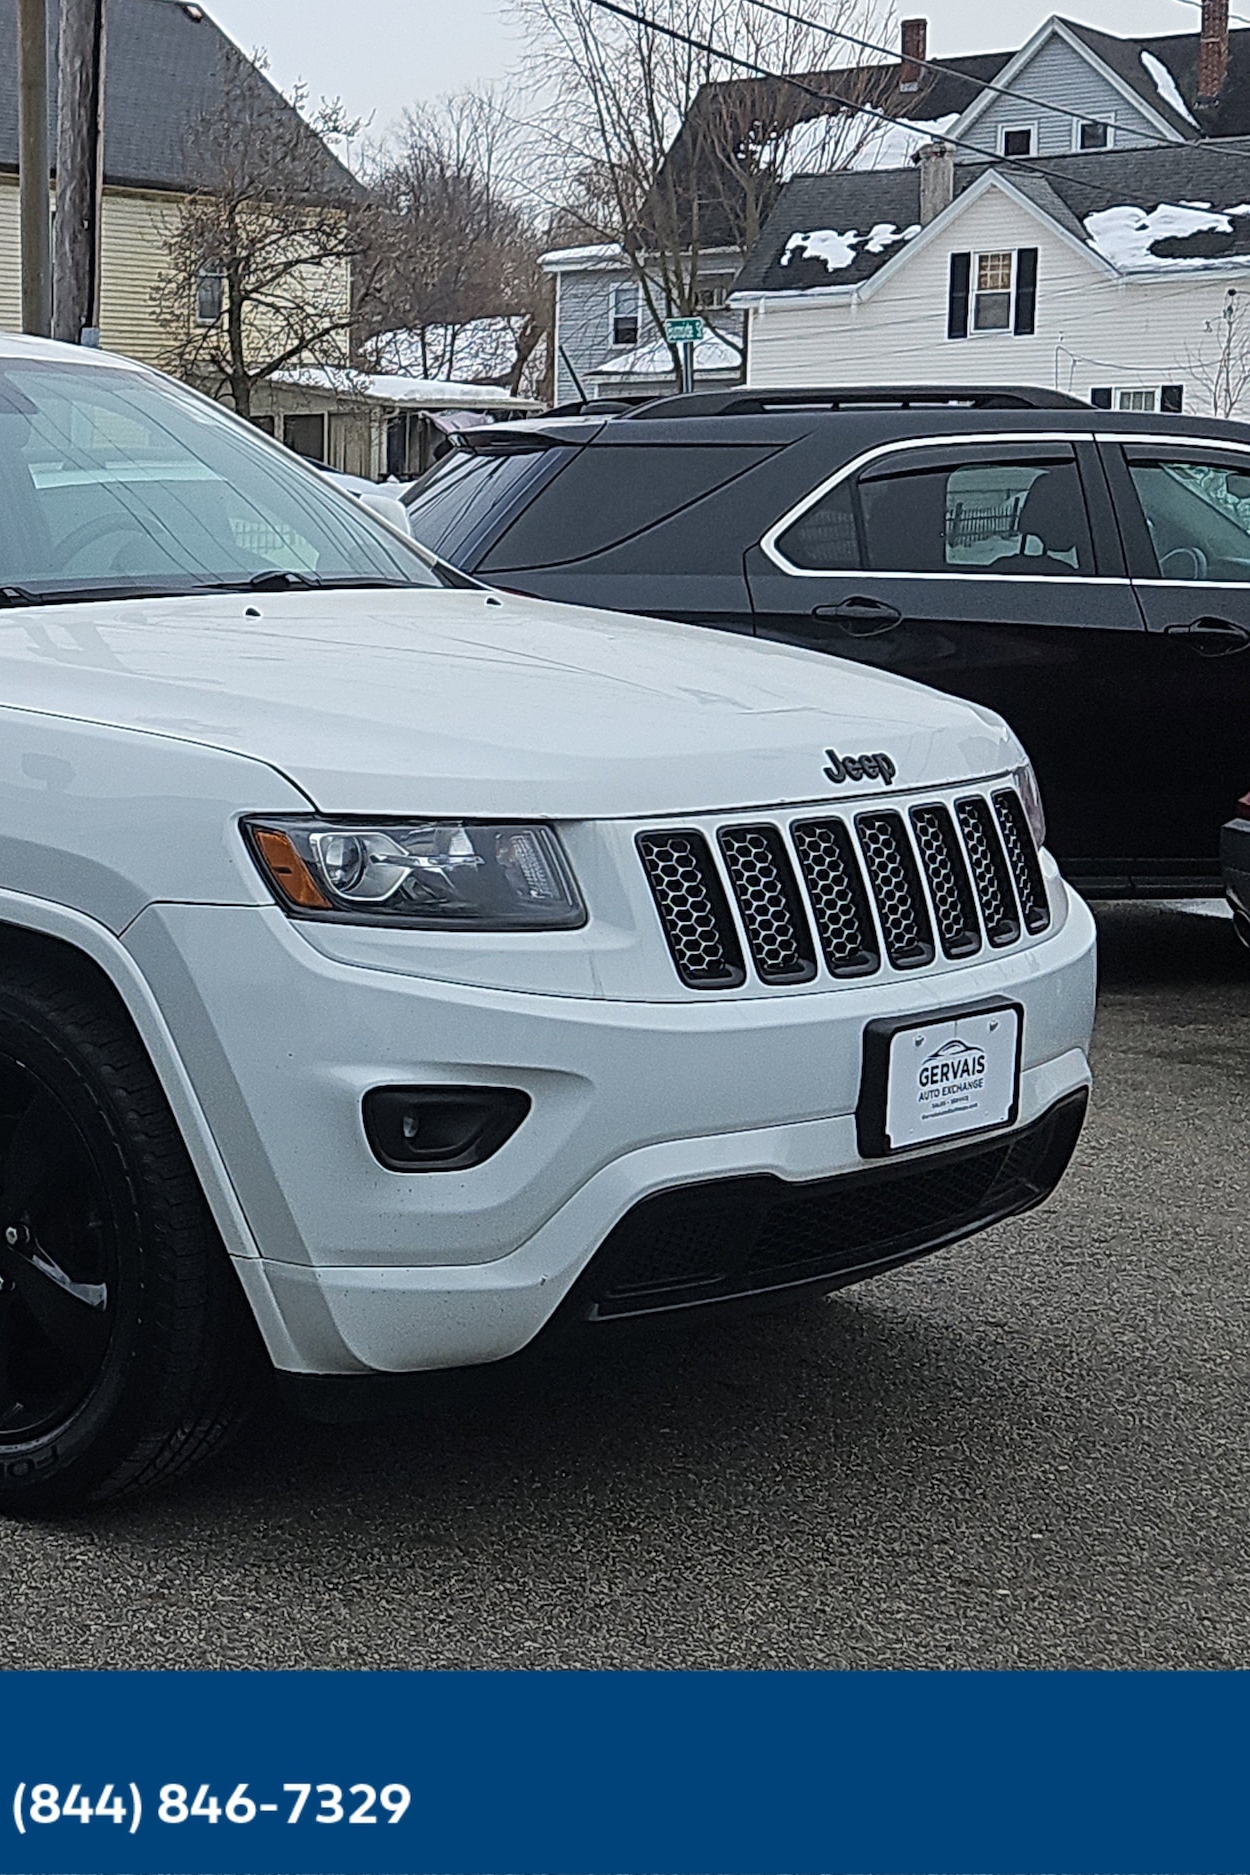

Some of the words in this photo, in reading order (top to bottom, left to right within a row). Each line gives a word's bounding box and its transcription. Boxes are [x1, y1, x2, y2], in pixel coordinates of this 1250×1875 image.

[823, 749, 896, 786] Jeep
[919, 1055, 986, 1087] GERVAIS
[918, 1089, 940, 1102] AUTO
[942, 1078, 984, 1097] EXCHANGE
